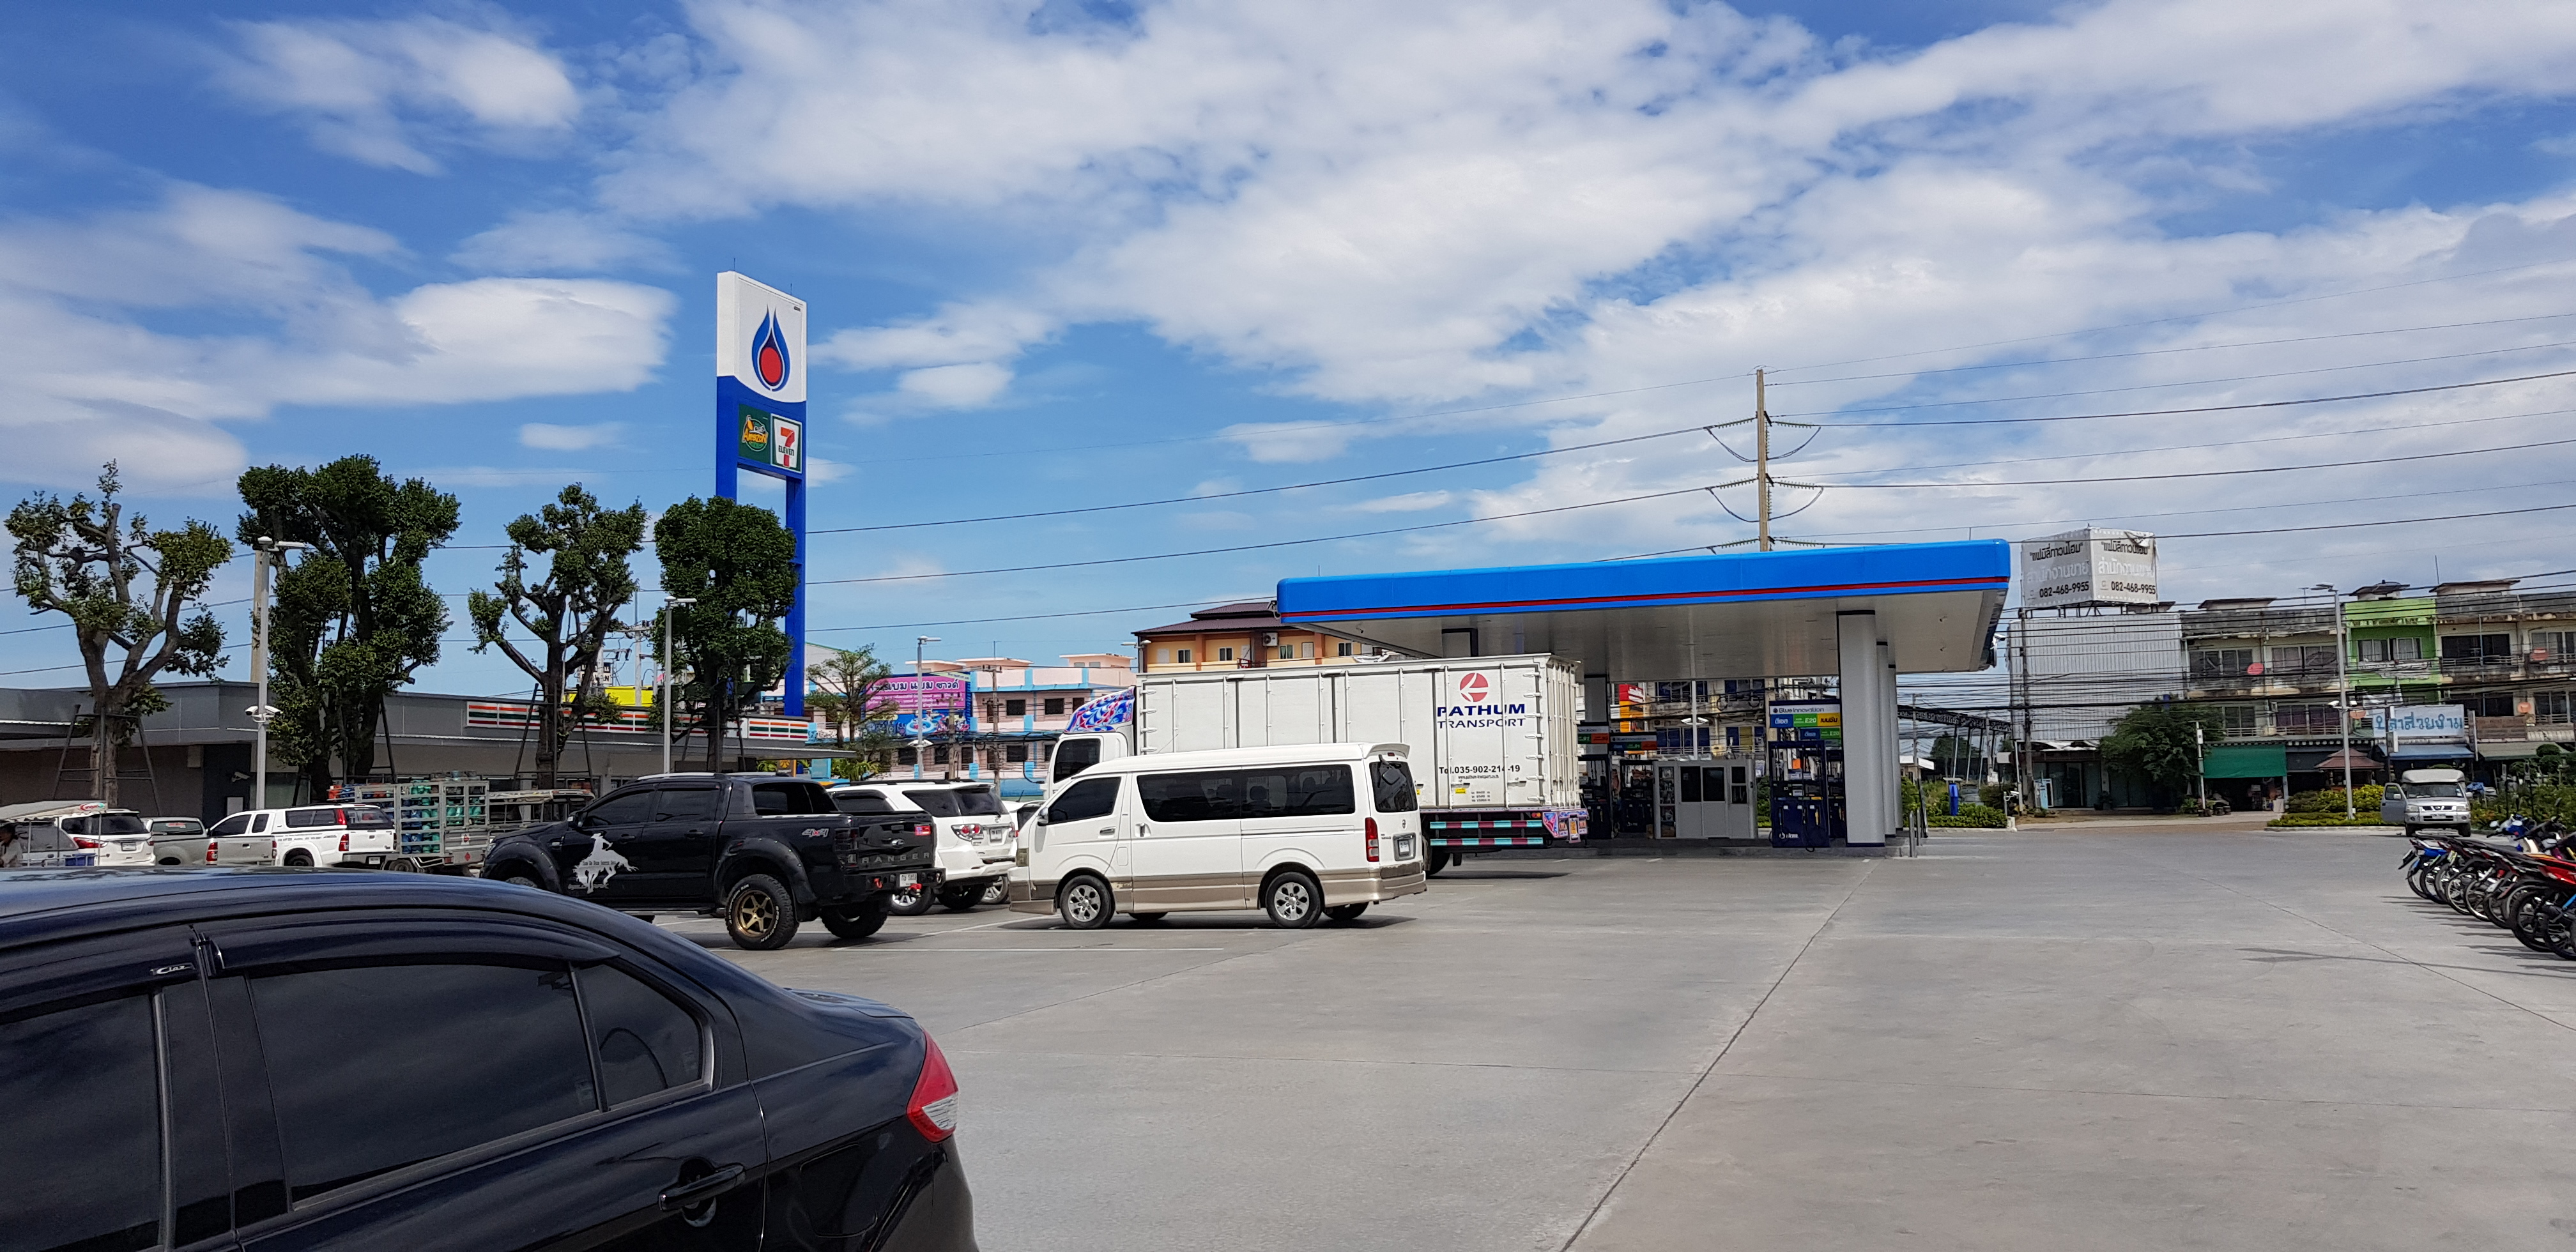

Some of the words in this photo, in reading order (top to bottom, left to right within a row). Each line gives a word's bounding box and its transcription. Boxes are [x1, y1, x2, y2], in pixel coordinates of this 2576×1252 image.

[2039, 581, 2089, 598] 082-468-9955
[2111, 581, 2156, 595] 082-468-9955
[1438, 704, 1525, 717] PATHUM
[1438, 718, 1526, 729] TRANSPORT
[862, 852, 930, 863] RANGER
